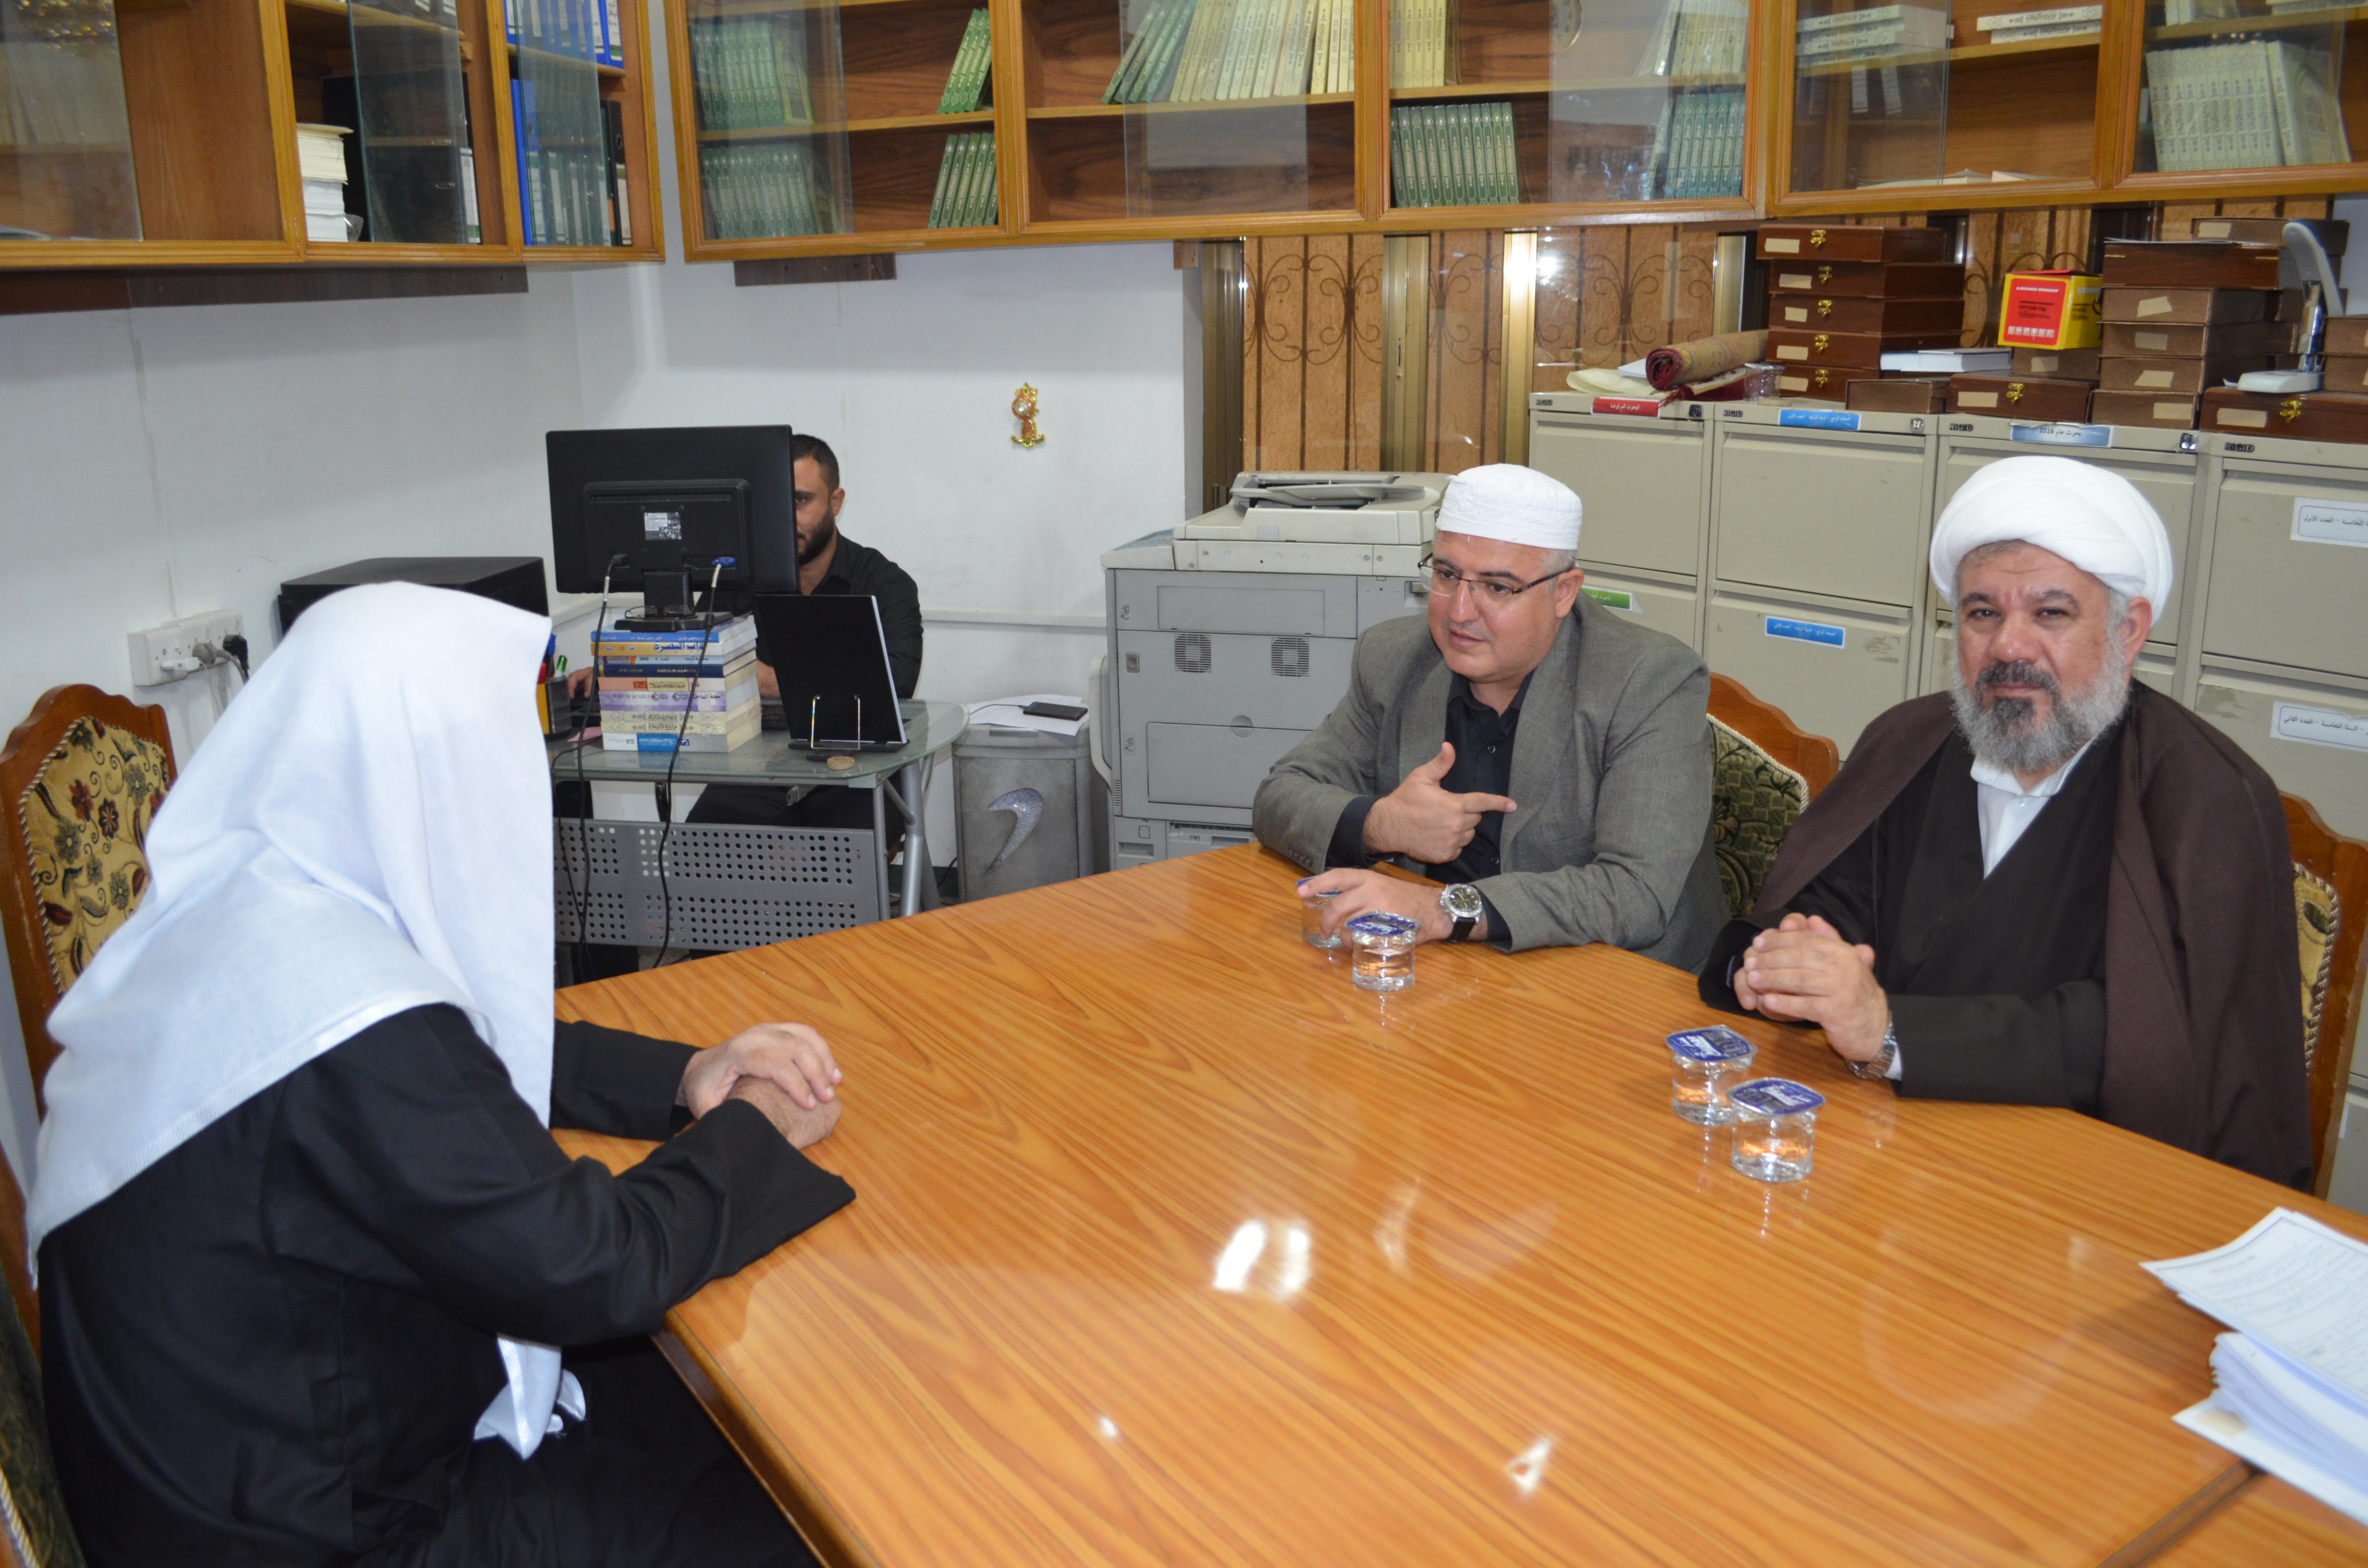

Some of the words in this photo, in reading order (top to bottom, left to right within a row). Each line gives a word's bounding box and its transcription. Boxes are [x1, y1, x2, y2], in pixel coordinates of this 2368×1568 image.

[2056, 429, 2064, 437] عام
[2224, 442, 2254, 453] RIGID
[2343, 517, 2364, 526] الخامسة
[654, 642, 685, 652] البصرة
[2283, 716, 2297, 724] الثاني
